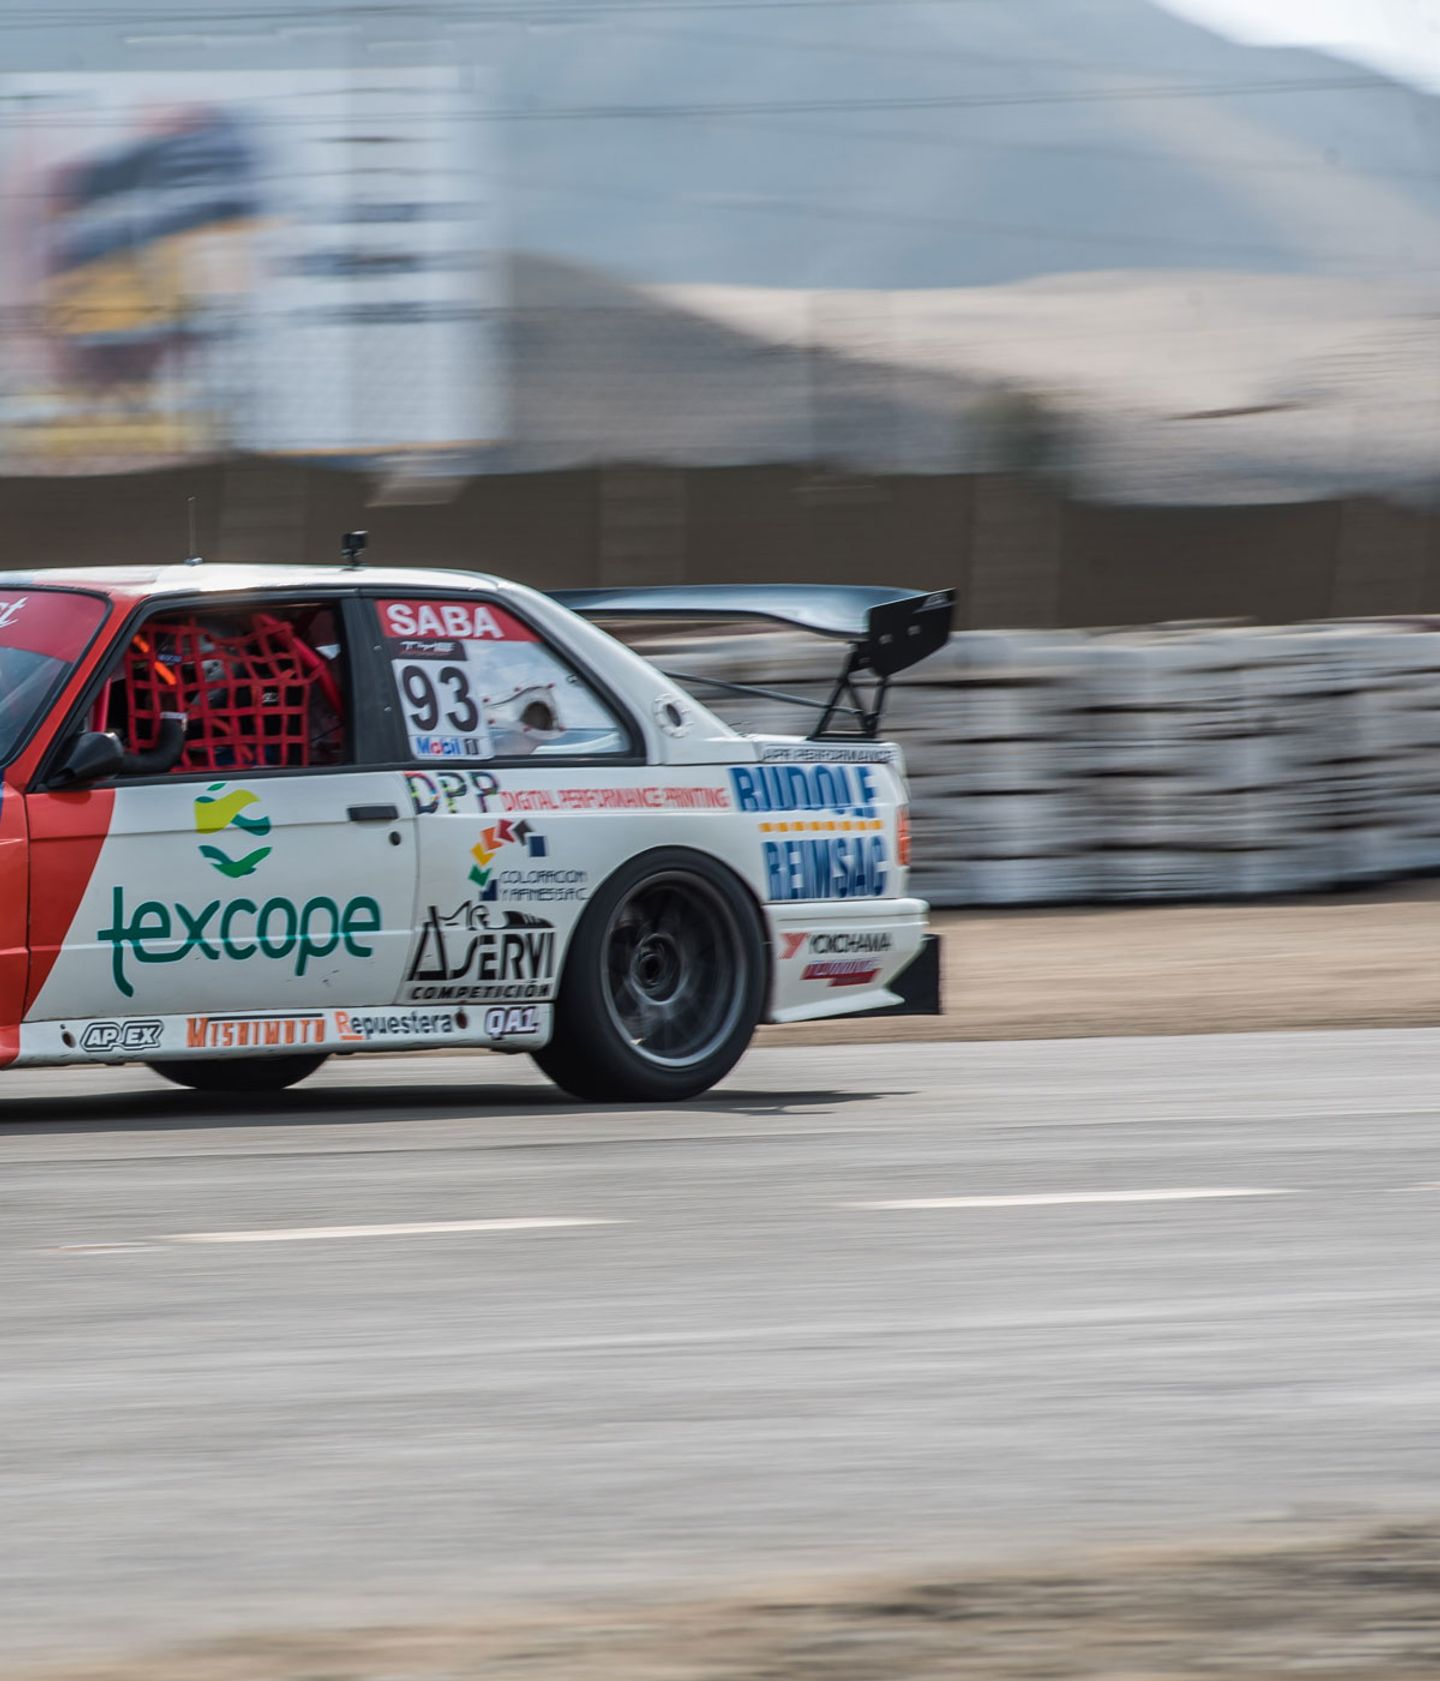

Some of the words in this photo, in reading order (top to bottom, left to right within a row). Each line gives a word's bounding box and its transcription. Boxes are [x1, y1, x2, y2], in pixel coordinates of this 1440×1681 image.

[386, 603, 505, 638] SABA
[402, 665, 479, 732] 93
[415, 737, 460, 755] Mobil
[404, 771, 500, 813] DPP
[499, 789, 559, 811] DIGITAL
[559, 787, 662, 809] PERFORMANCE
[97, 886, 381, 998] texcope
[411, 981, 551, 1000] COMPETICIÓN
[186, 1017, 327, 1048] MISHIMOTO
[334, 1010, 453, 1040] Repuestera
